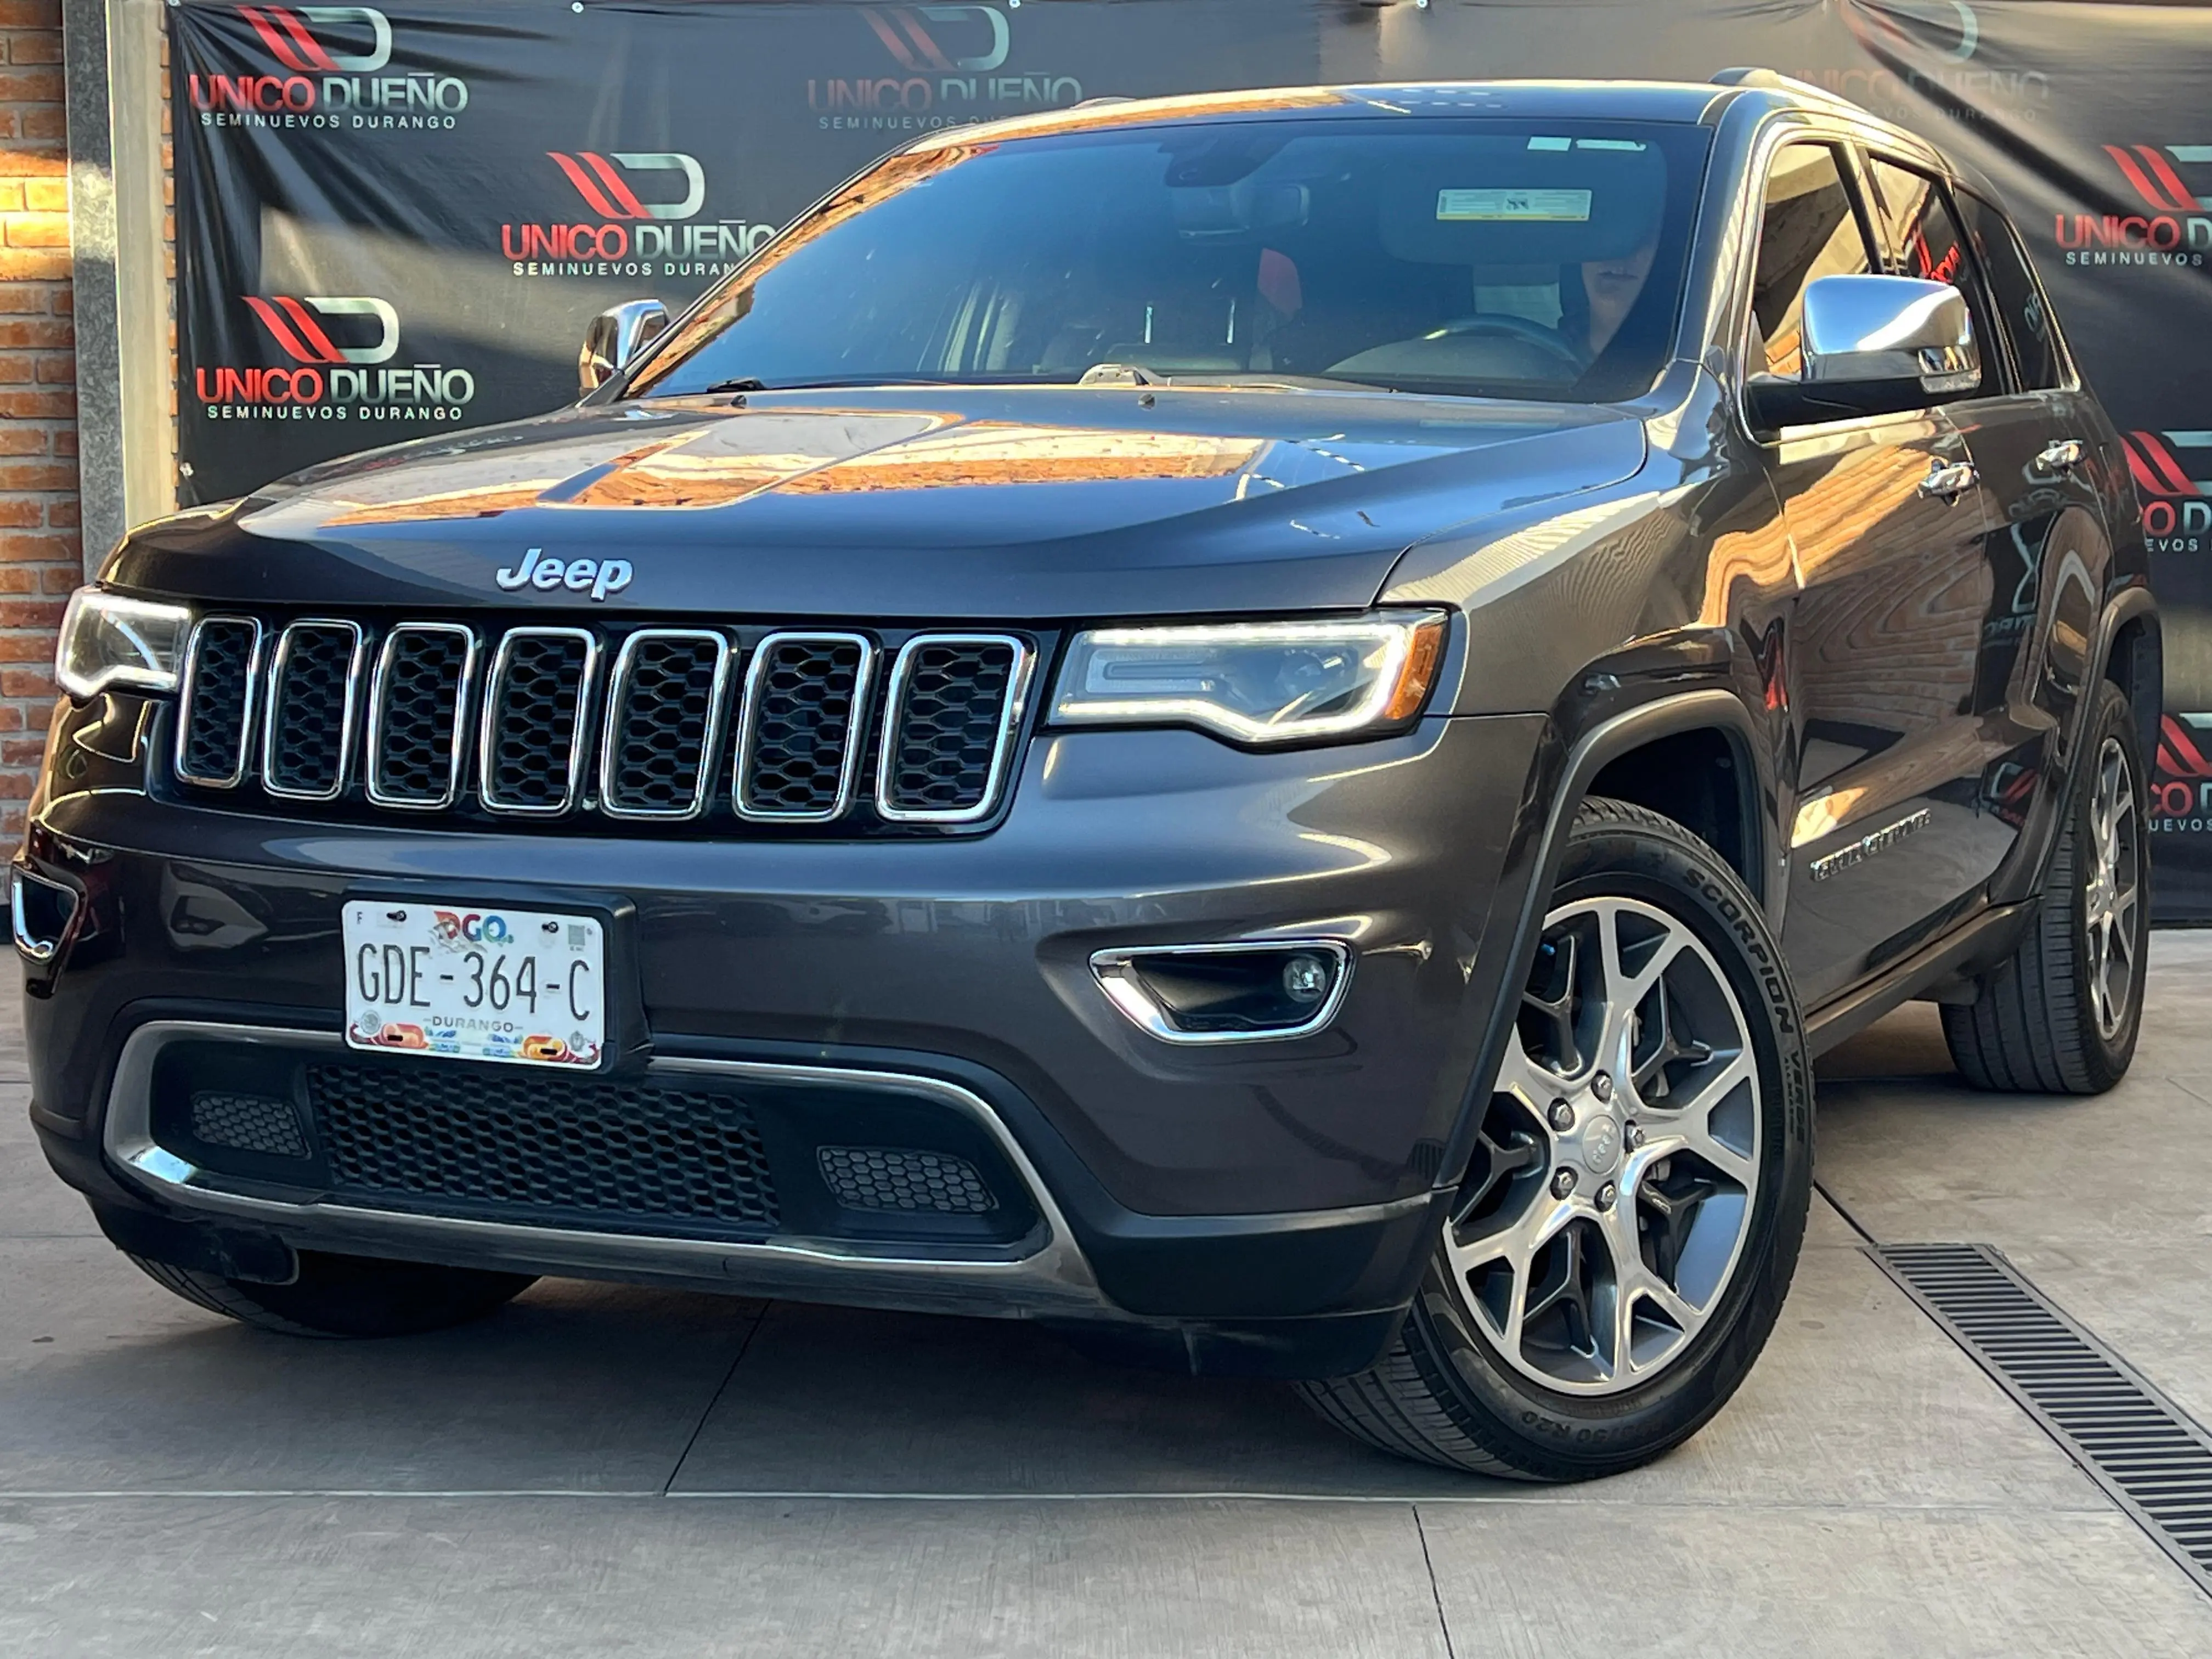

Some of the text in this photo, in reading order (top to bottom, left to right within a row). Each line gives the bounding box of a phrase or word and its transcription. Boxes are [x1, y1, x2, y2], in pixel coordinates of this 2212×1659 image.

[189, 72, 468, 112] UNICO DUEÑO
[808, 77, 932, 111] UNICO
[201, 112, 456, 129] SEMINUEVOS DURANGO
[819, 115, 956, 129] SEMINUEVOS
[501, 224, 628, 261] UNICO
[2056, 214, 2181, 251] UNICO
[514, 262, 652, 276] SEMINUEVOS
[2066, 251, 2203, 266] SEMINUEVOS
[196, 364, 474, 405] UNICO DUEÑO
[208, 405, 462, 420] SEMINUEVOS DURANGO
[496, 548, 633, 601] Jeep
[1685, 868, 1793, 1034] SCORPION
[358, 943, 590, 1020] GDE-364-C
[432, 1015, 514, 1033] DURANGO
